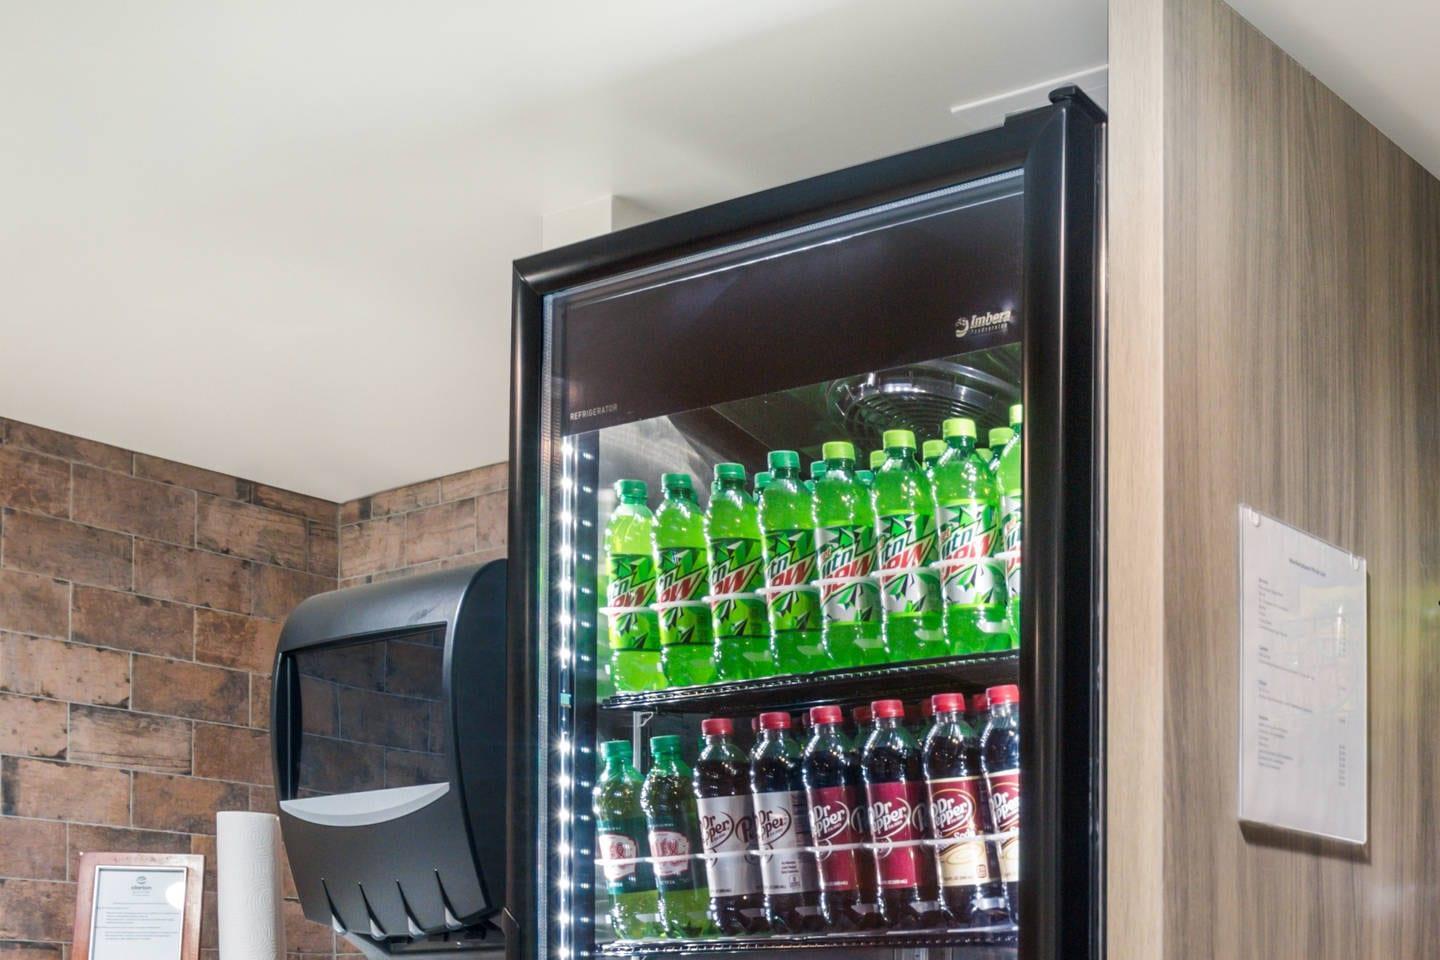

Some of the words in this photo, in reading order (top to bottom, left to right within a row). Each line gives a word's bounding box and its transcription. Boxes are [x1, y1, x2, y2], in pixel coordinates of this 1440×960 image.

[970, 310, 1011, 329] Imbera
[814, 804, 831, 820] Dr
[873, 801, 892, 817] Dr
[937, 798, 955, 812] Dr
